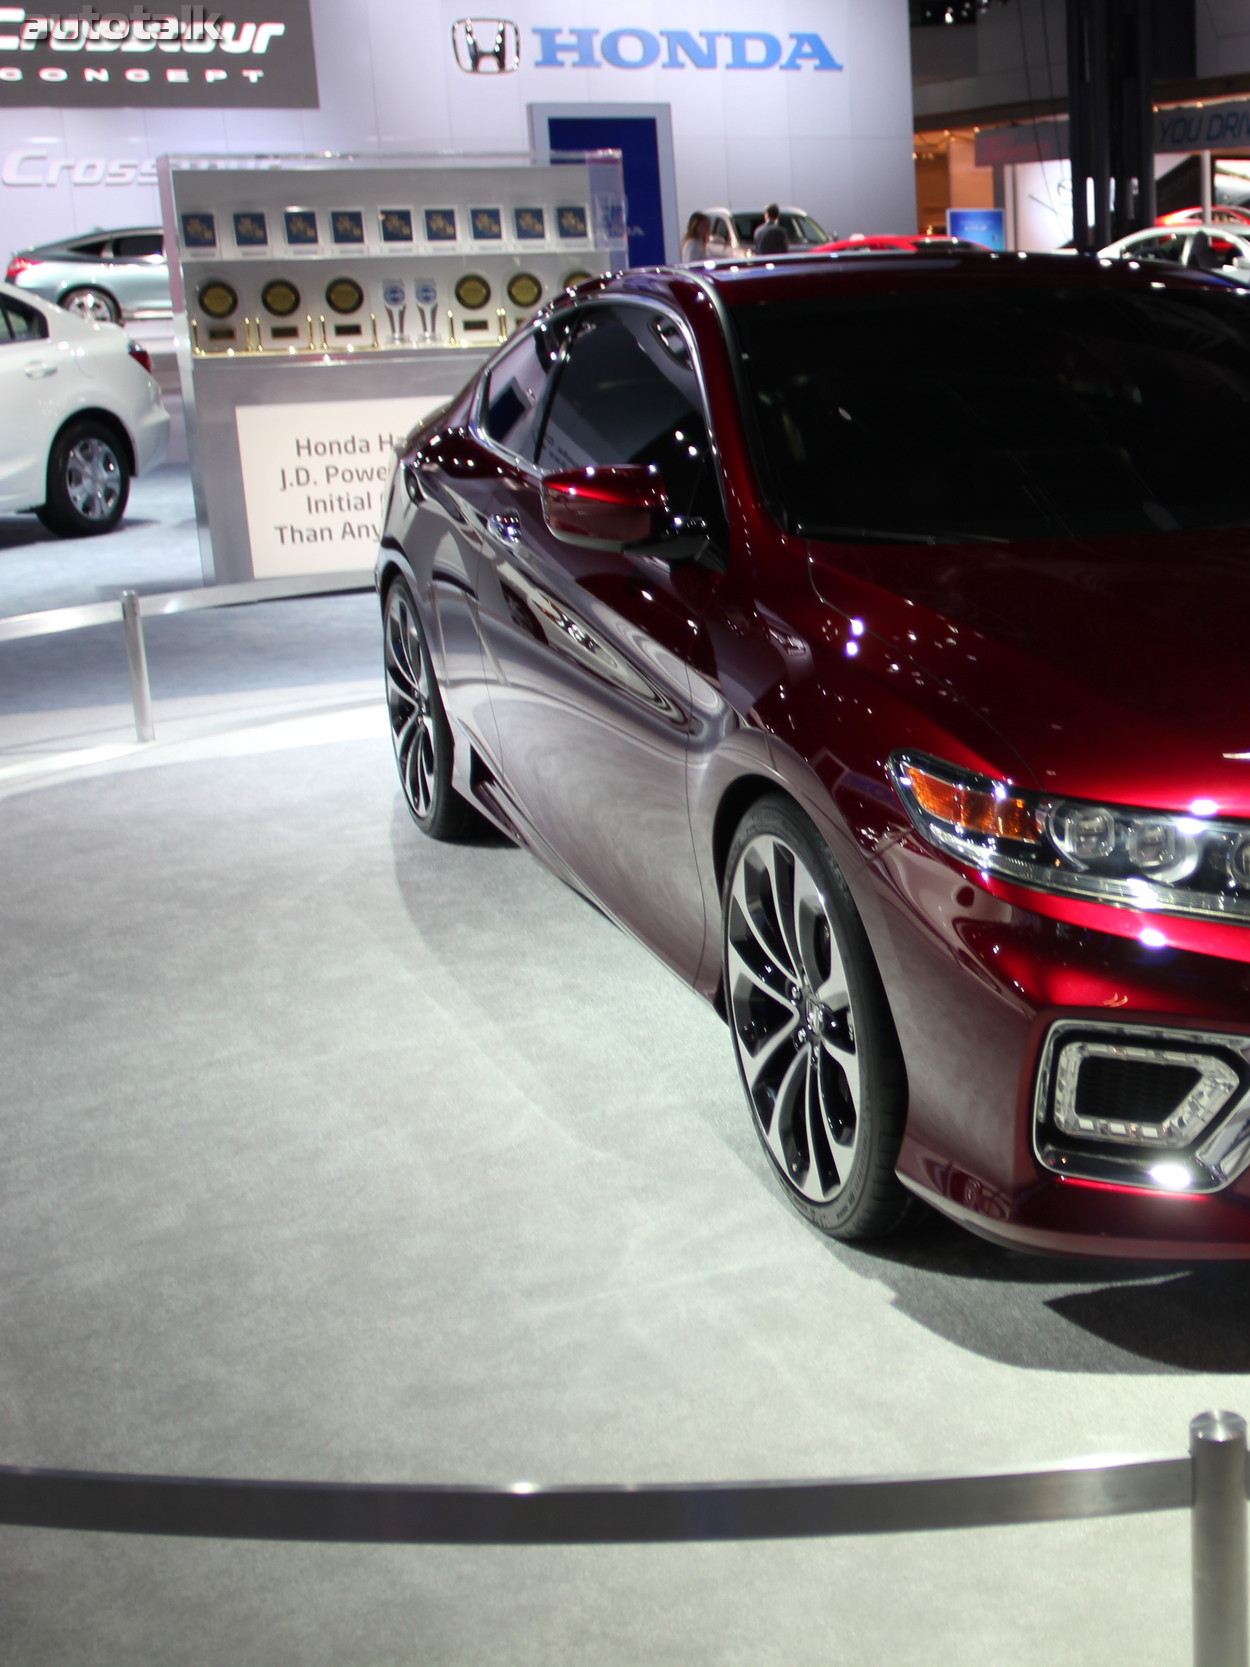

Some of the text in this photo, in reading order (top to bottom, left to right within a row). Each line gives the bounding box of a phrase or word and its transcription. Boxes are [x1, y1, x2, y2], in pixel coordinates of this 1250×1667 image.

[531, 27, 844, 71] HONDA
[0, 67, 264, 83] CONCEPT
[294, 435, 371, 457] Honda
[280, 466, 318, 491] J.D.
[306, 492, 372, 514] Initial
[274, 521, 381, 545] Than Any
